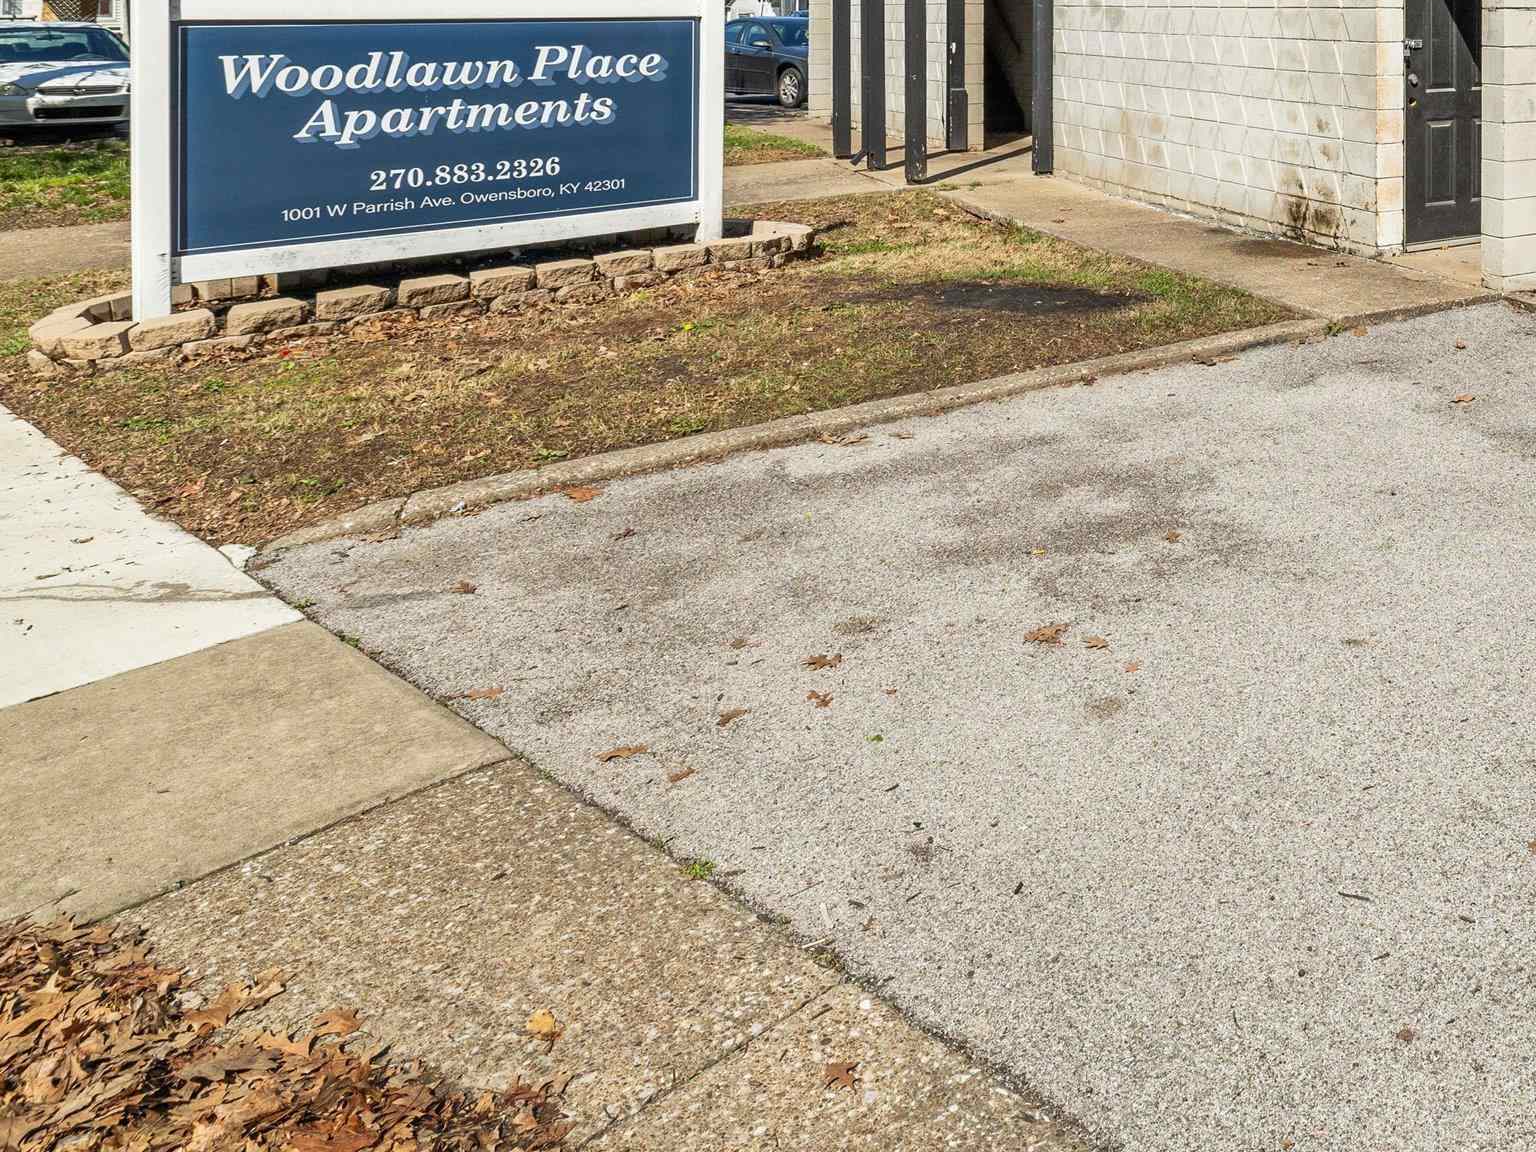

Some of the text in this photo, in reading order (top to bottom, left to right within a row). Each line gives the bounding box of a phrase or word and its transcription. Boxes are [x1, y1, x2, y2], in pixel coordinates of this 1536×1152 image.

[217, 44, 664, 97] Woodlawn Place
[291, 92, 616, 147] Apartments
[368, 156, 561, 191] 270.883.2326
[281, 178, 625, 222] 1001 W Parrish Ave. Owensboro, KY 42301
